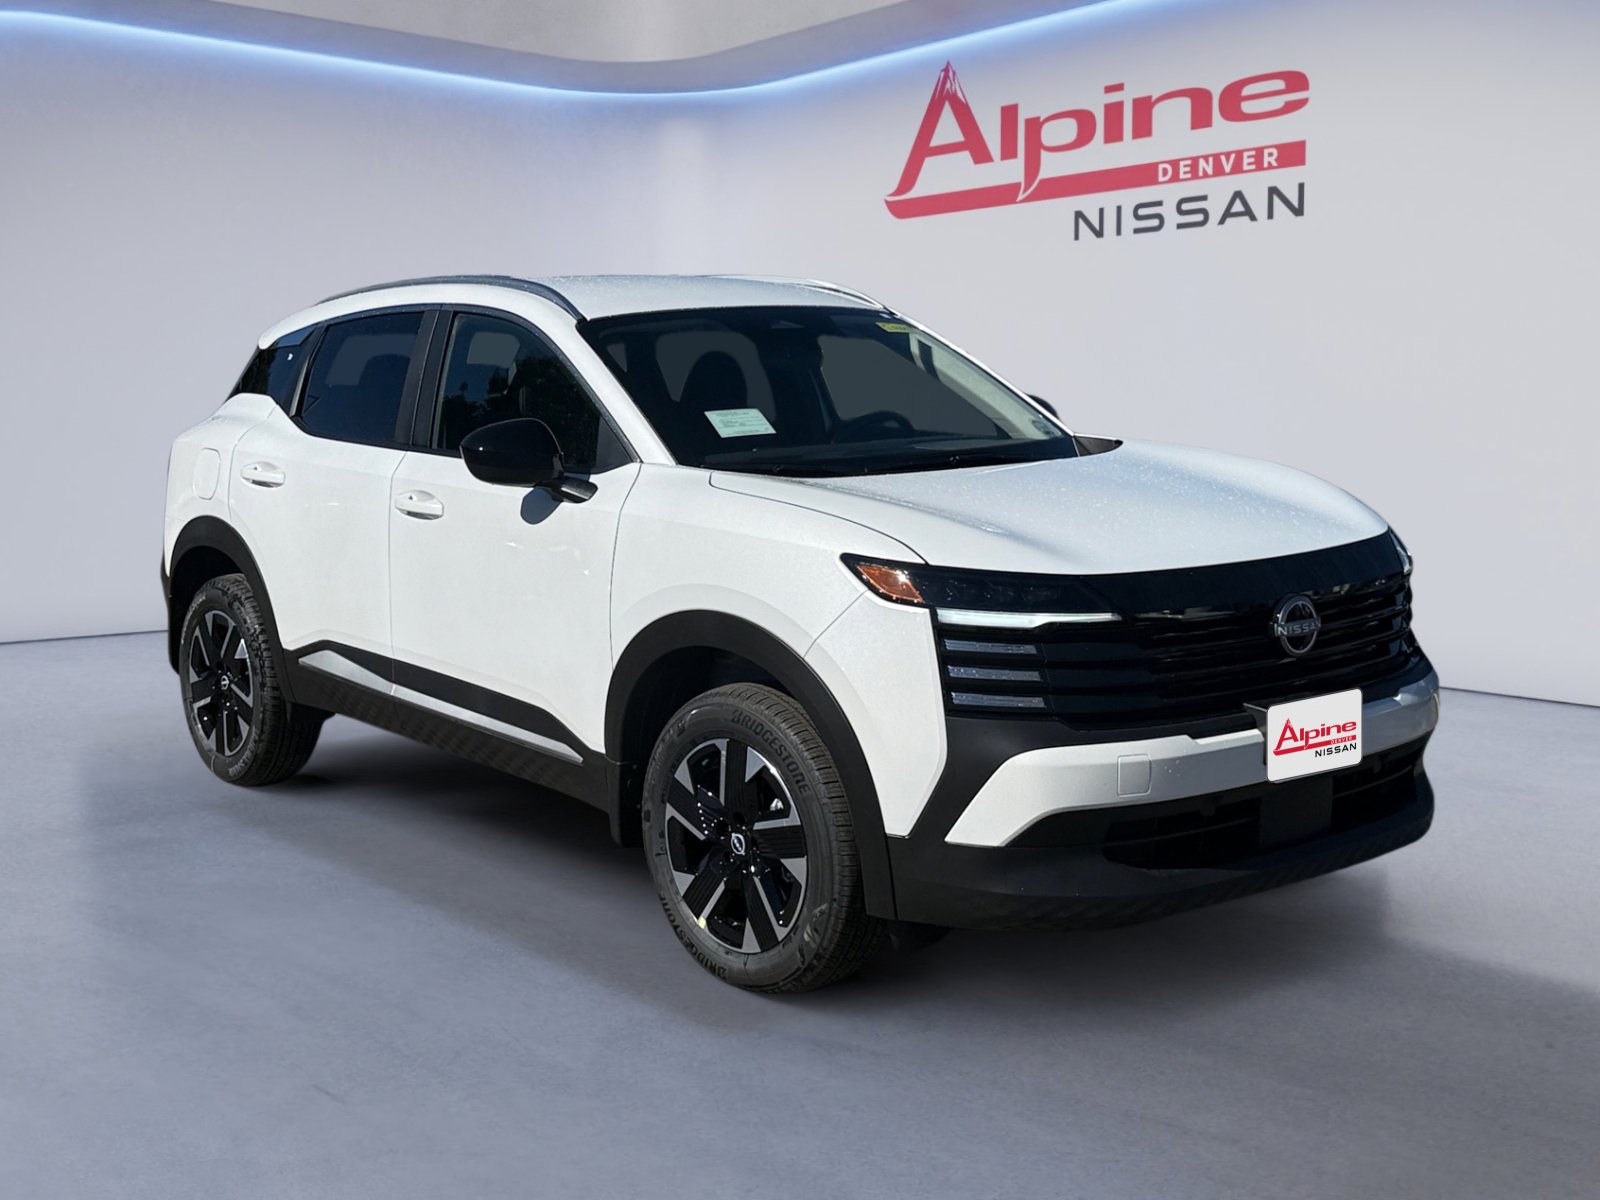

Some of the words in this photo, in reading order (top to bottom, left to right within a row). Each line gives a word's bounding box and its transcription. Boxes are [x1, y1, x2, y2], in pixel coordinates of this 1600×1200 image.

[886, 60, 1310, 202] Alpine
[1157, 147, 1279, 183] DENVER
[1073, 182, 1306, 242] NISSAN
[730, 708, 811, 794] BRIDGESTONE
[1274, 717, 1357, 749] Alpine
[1314, 742, 1357, 758] NISSAN
[1330, 735, 1353, 745] DENVER
